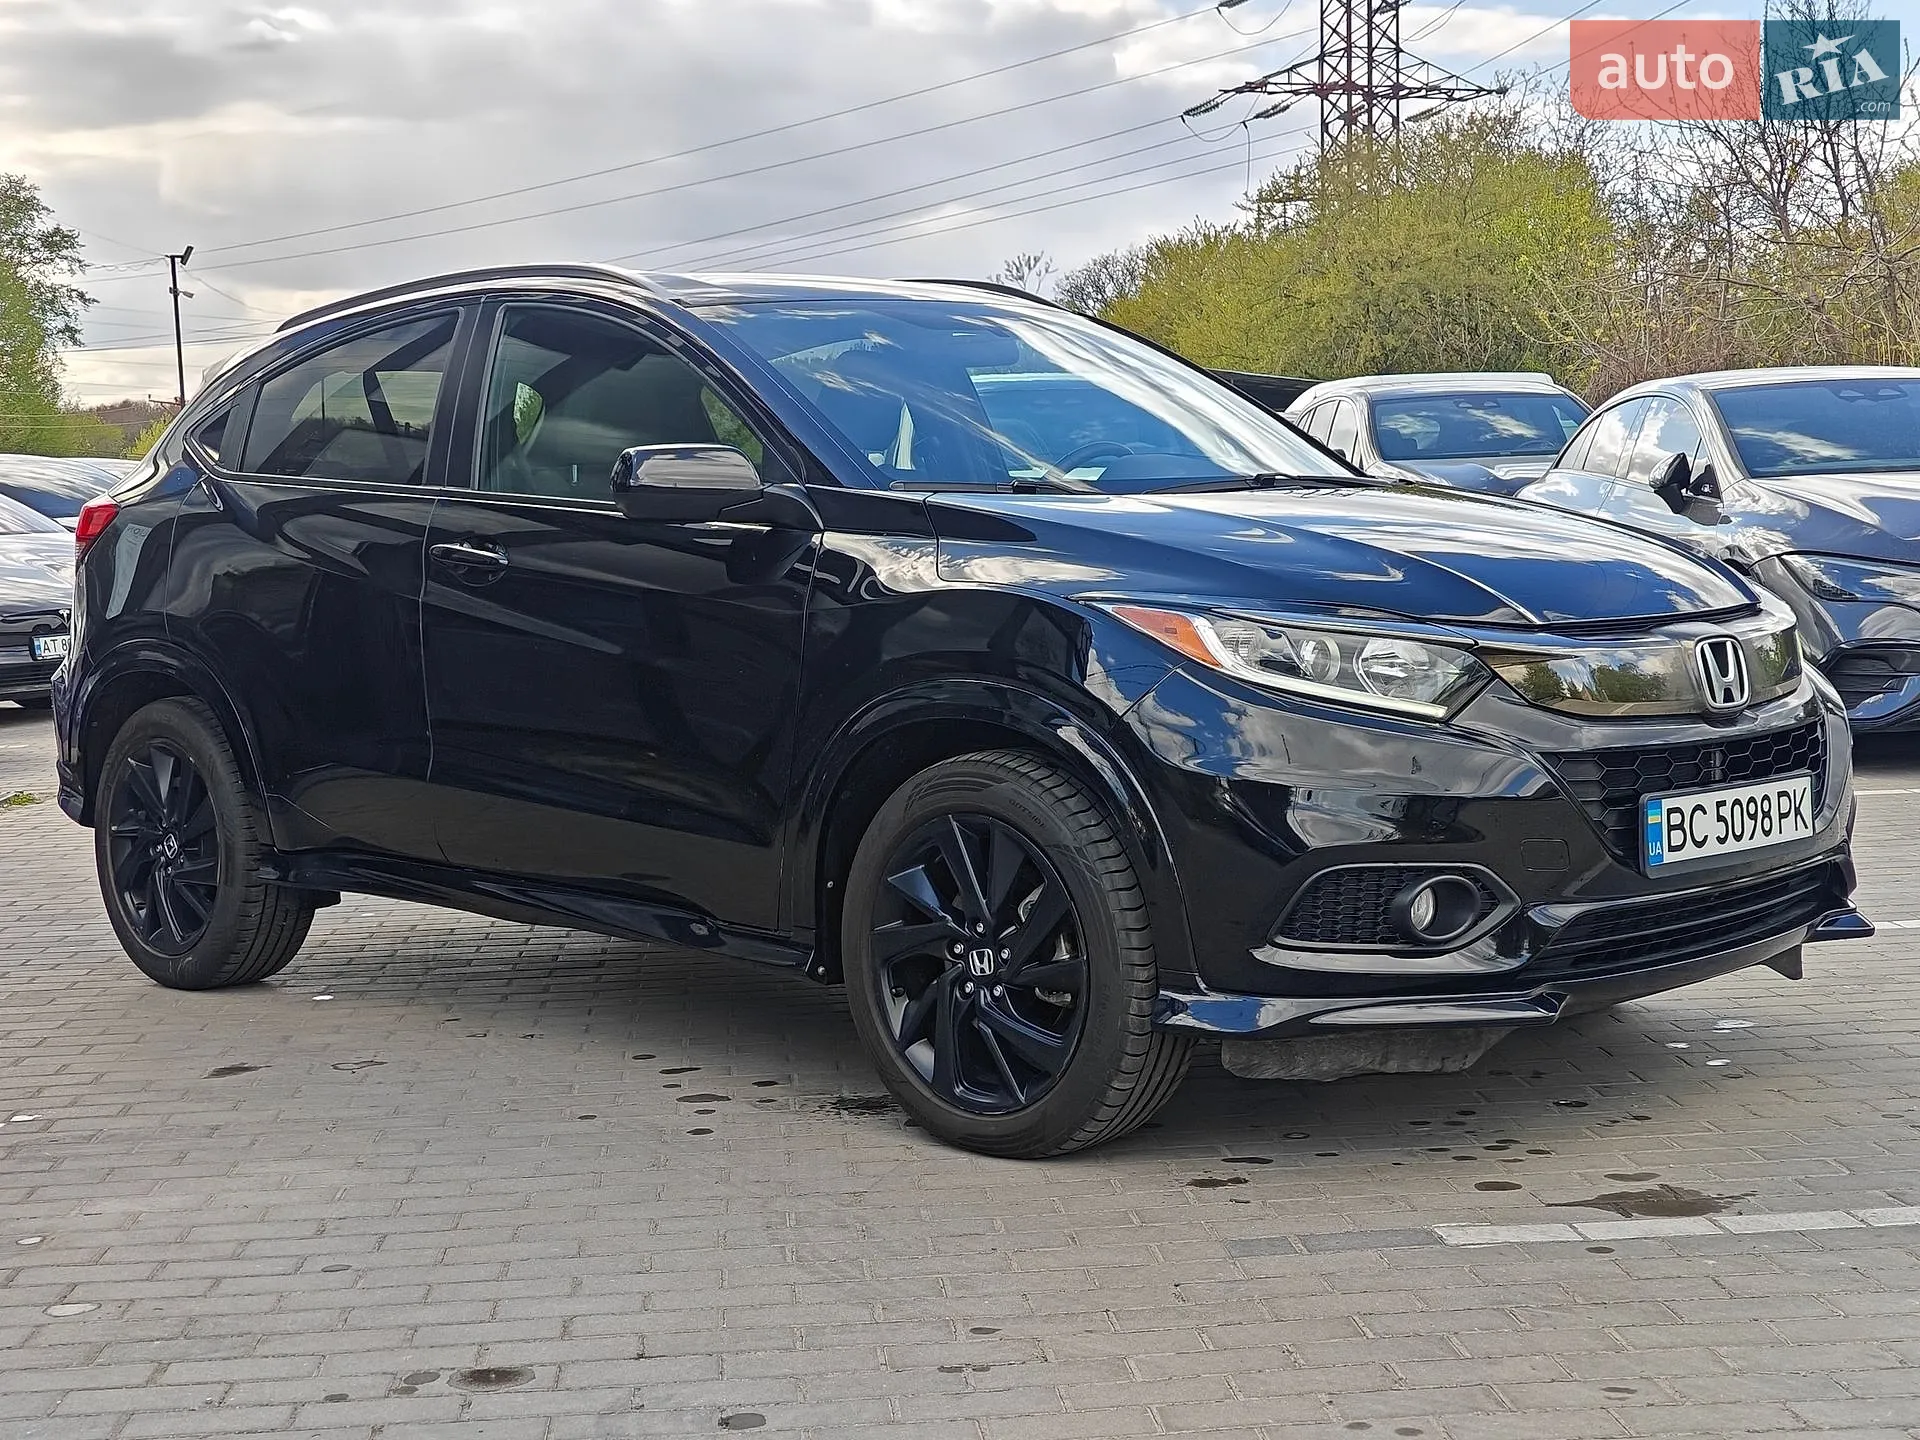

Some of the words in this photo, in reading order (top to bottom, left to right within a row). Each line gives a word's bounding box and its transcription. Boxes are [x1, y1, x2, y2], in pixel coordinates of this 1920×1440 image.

[43, 639, 58, 654] AT
[1666, 803, 1709, 853] BC
[1715, 793, 1773, 845] 5098
[1777, 787, 1809, 835] PK
[1649, 842, 1662, 856] UA
